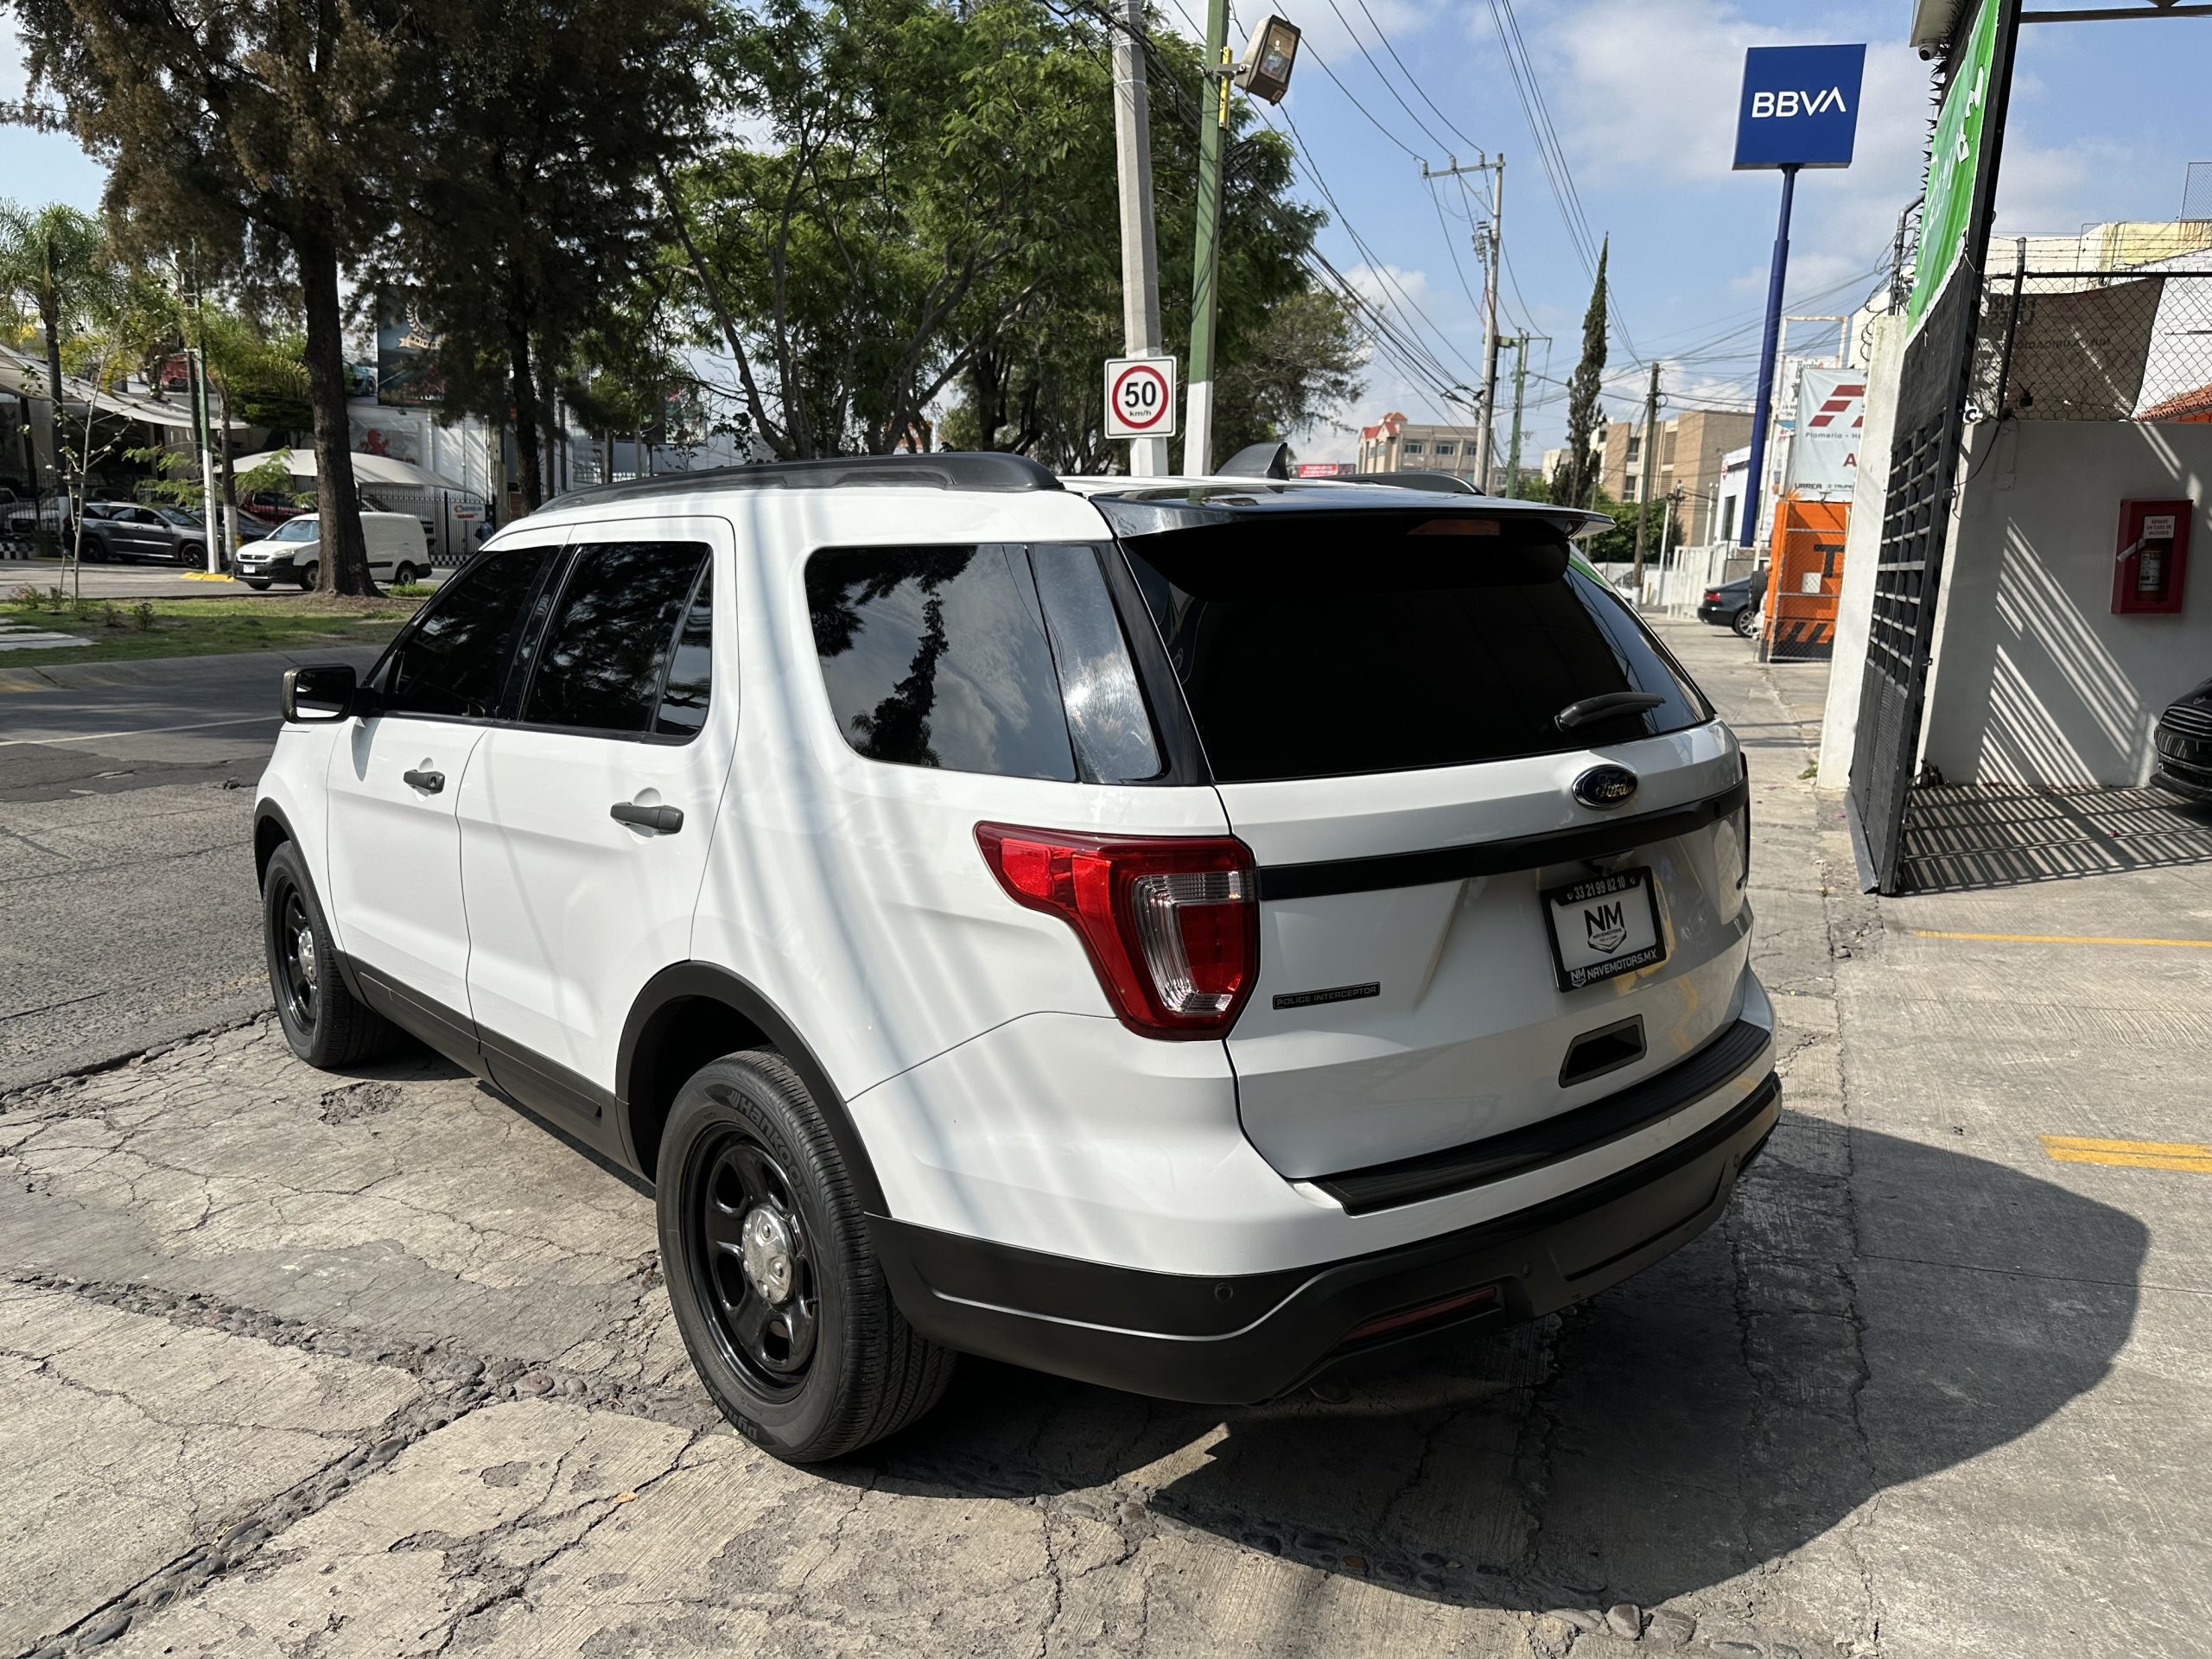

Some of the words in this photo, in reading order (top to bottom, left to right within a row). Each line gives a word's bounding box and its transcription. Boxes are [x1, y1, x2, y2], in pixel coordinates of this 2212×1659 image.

[1751, 86, 1847, 118] BBVA
[1124, 381, 1156, 408] 50
[1595, 773, 1633, 798] Ford
[1573, 885, 1586, 900] 33
[1585, 882, 1596, 897] 21
[1595, 880, 1606, 895] 99
[1606, 877, 1618, 892] 82
[1617, 874, 1626, 889] 10
[1584, 901, 1625, 938] NM
[1586, 949, 1658, 981] NAVEMOTORS.MX
[1276, 995, 1312, 1007] POLICE
[1313, 986, 1377, 1001] INTERCEPTOR
